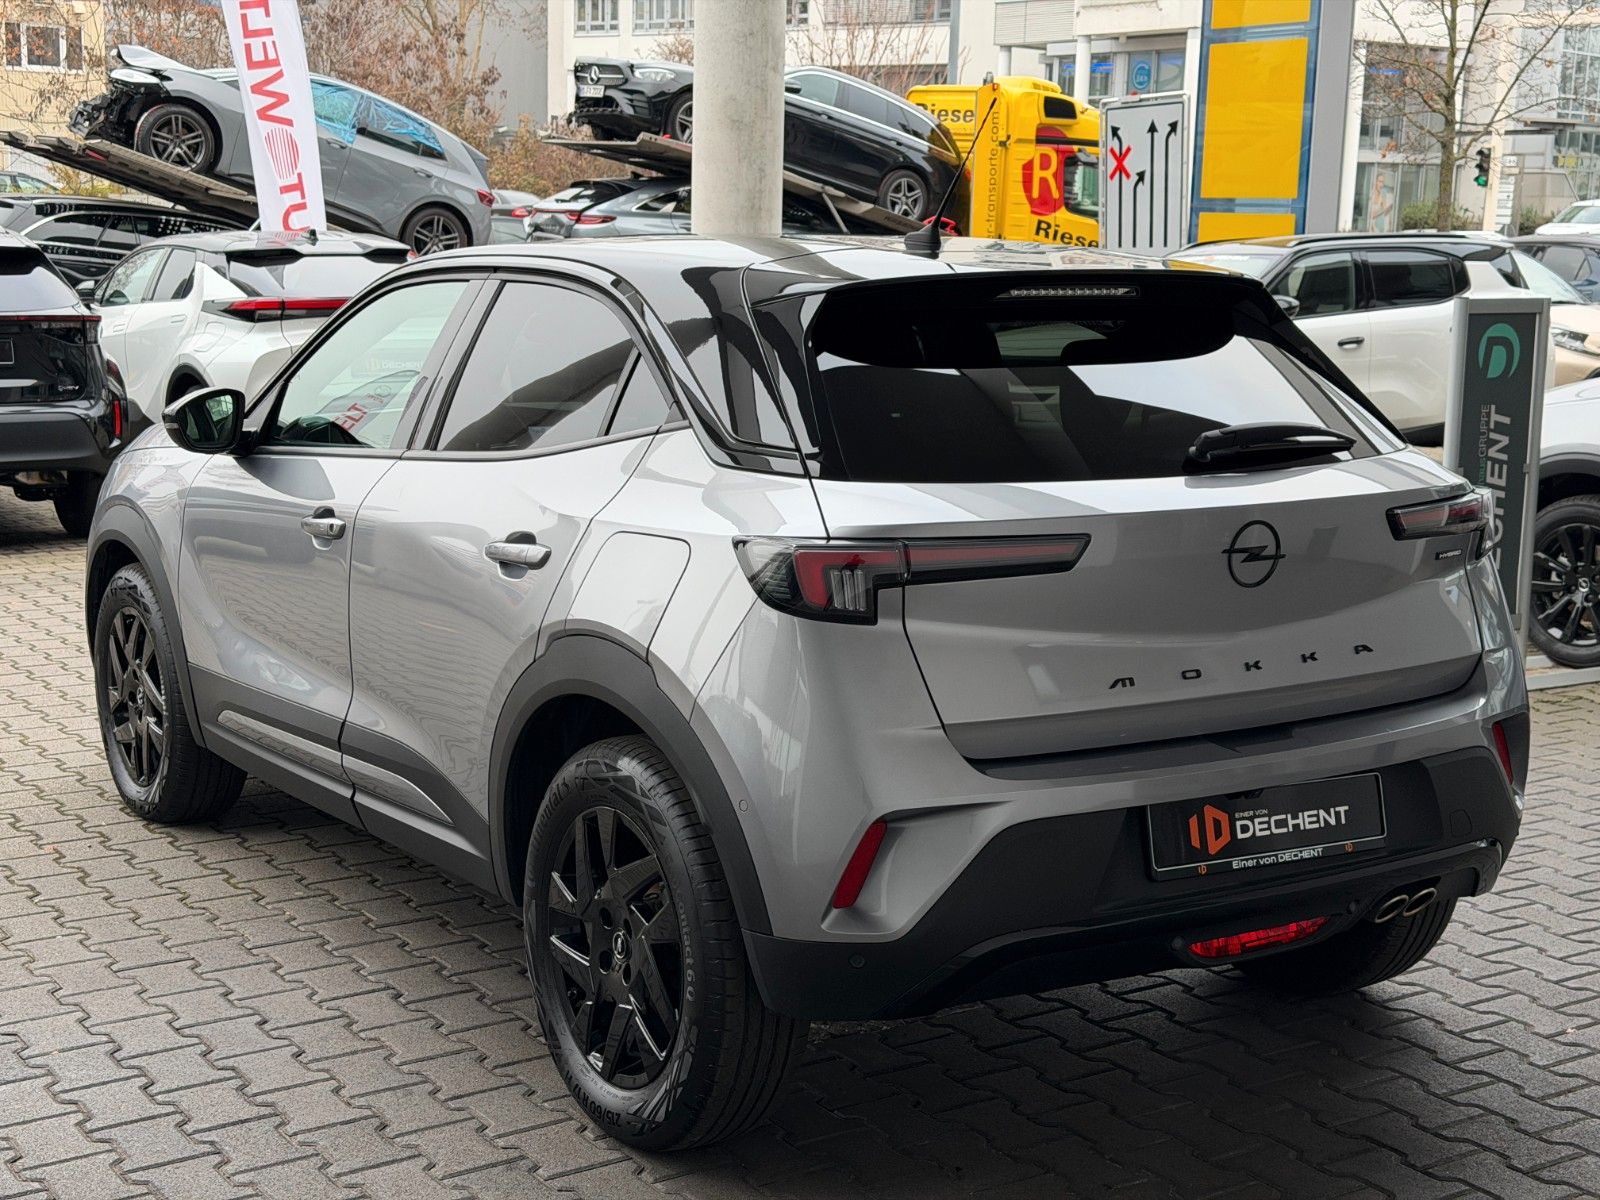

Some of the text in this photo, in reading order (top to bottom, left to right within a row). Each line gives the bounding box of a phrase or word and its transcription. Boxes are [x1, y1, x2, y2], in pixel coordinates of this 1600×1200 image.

[915, 102, 975, 124] iese
[1034, 218, 1099, 249] Riese
[1108, 643, 1374, 690] MOKKA
[1235, 810, 1254, 819] EINER
[1235, 805, 1350, 840] DECHENT
[1232, 858, 1257, 870] Einer
[1259, 856, 1277, 866] von
[1278, 847, 1324, 862] DECHENT
